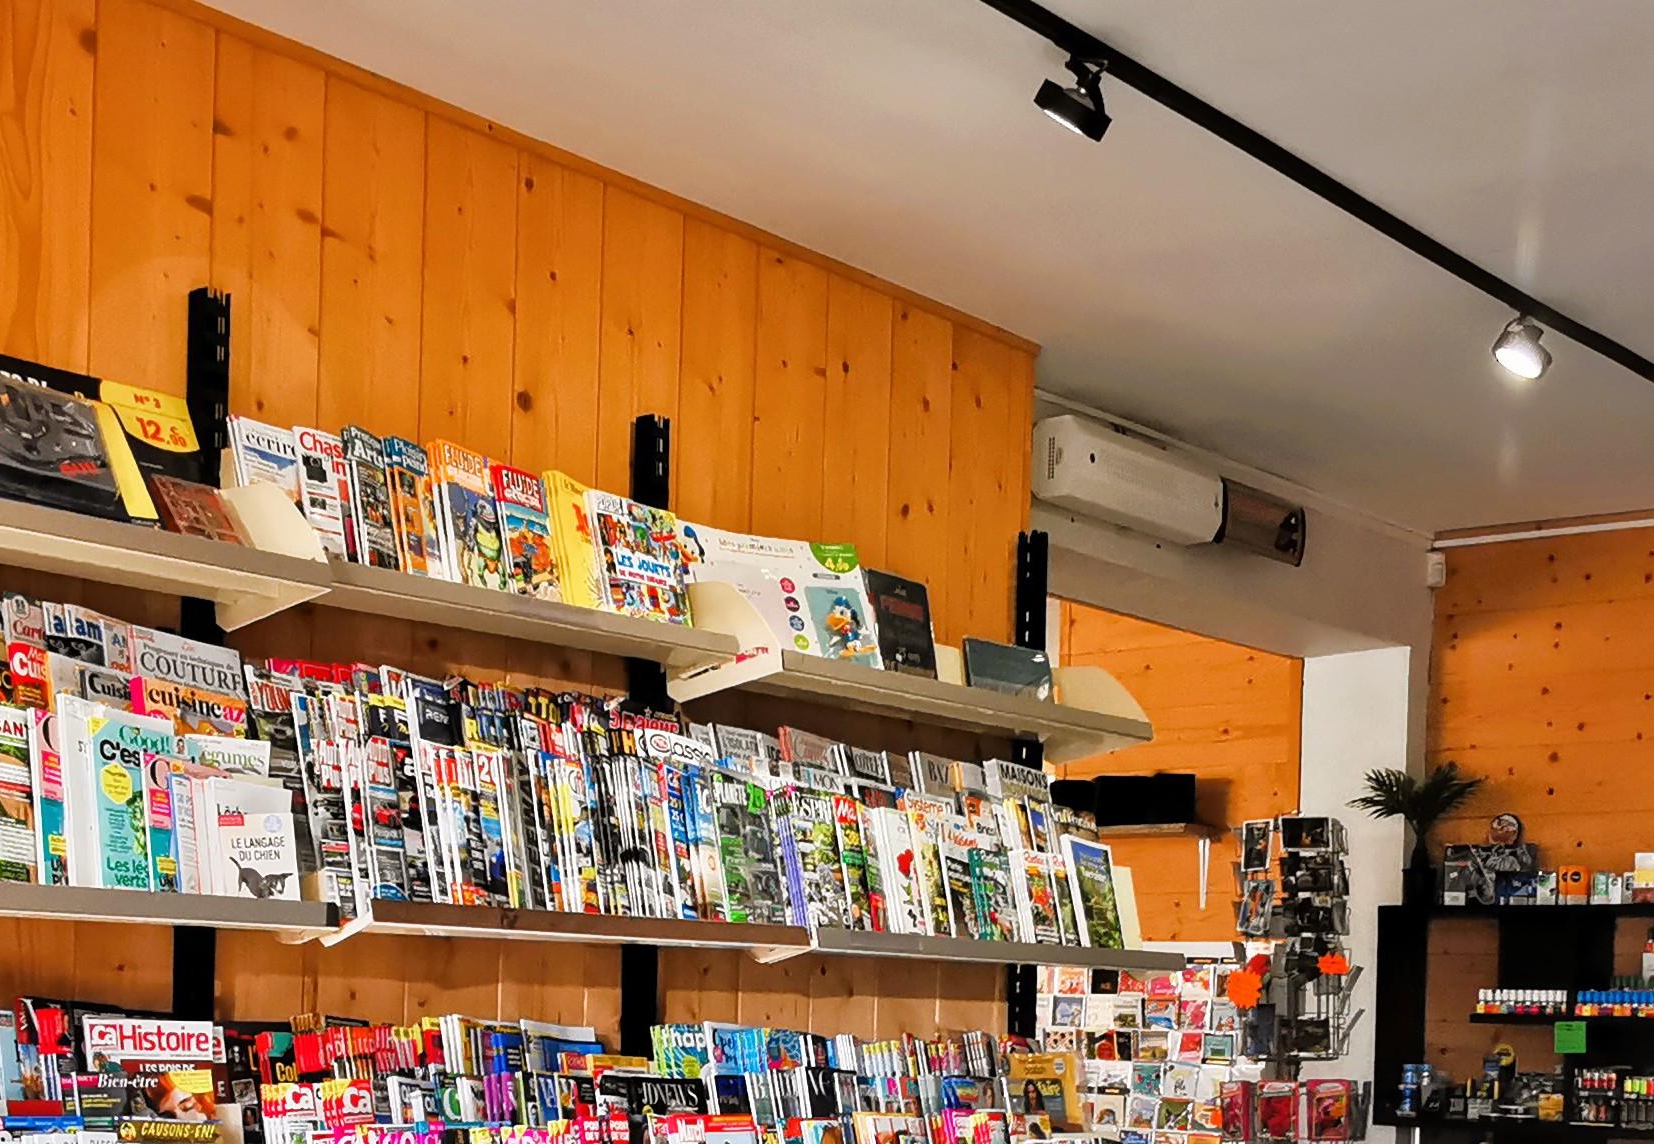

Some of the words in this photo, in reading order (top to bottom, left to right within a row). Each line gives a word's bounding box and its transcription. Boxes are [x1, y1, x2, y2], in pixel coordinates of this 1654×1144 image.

[636, 556, 672, 578] JOUETS
[118, 724, 172, 755] Good!
[231, 837, 242, 848] LE
[244, 835, 286, 849] LANGAGE
[239, 849, 252, 861] DU
[253, 848, 281, 861] CHIEN
[119, 1024, 209, 1052] Histoire
[97, 1073, 158, 1088] Bien-être
[141, 1122, 216, 1139] CAUSONS-EN!
